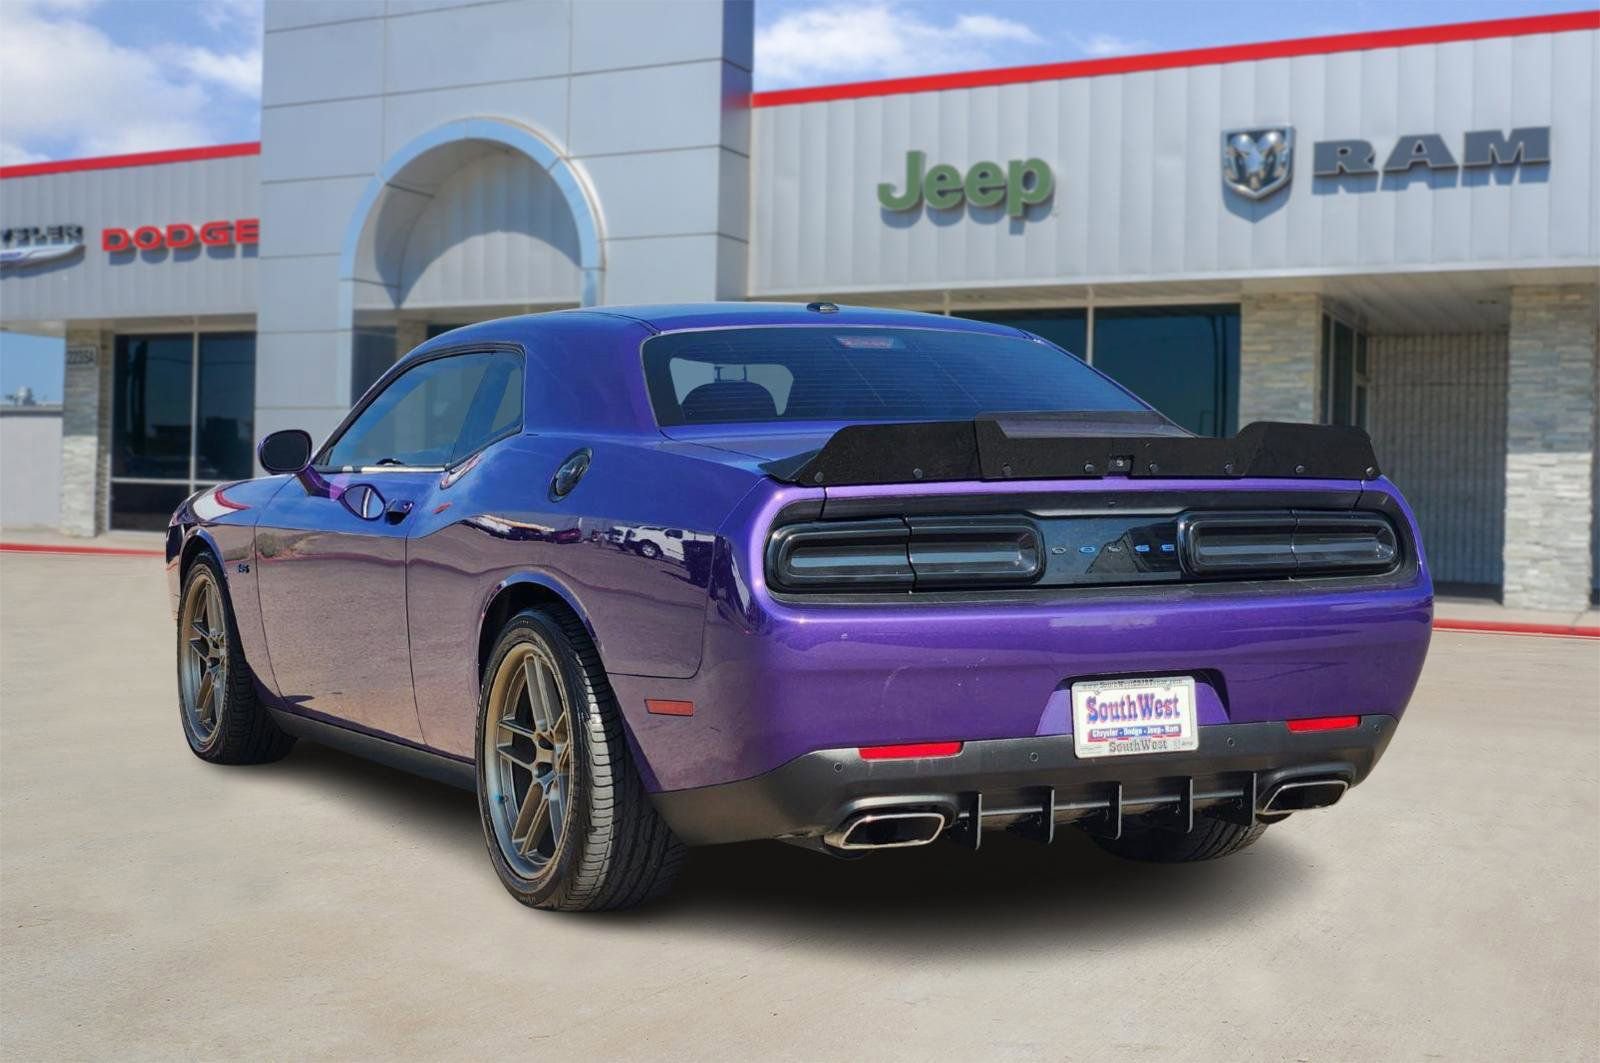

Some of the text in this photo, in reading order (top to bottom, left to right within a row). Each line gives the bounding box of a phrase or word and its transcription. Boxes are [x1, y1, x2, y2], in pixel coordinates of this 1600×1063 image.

[1312, 126, 1551, 175] RAM
[877, 150, 1055, 217] Jeep
[102, 218, 260, 251] DODGE
[1051, 543, 1175, 555] DODGE
[1086, 693, 1181, 723] SouthWest
[1092, 728, 1119, 739] Chrysler
[1123, 726, 1143, 737] Dodge
[1108, 739, 1168, 753] SouthWest
